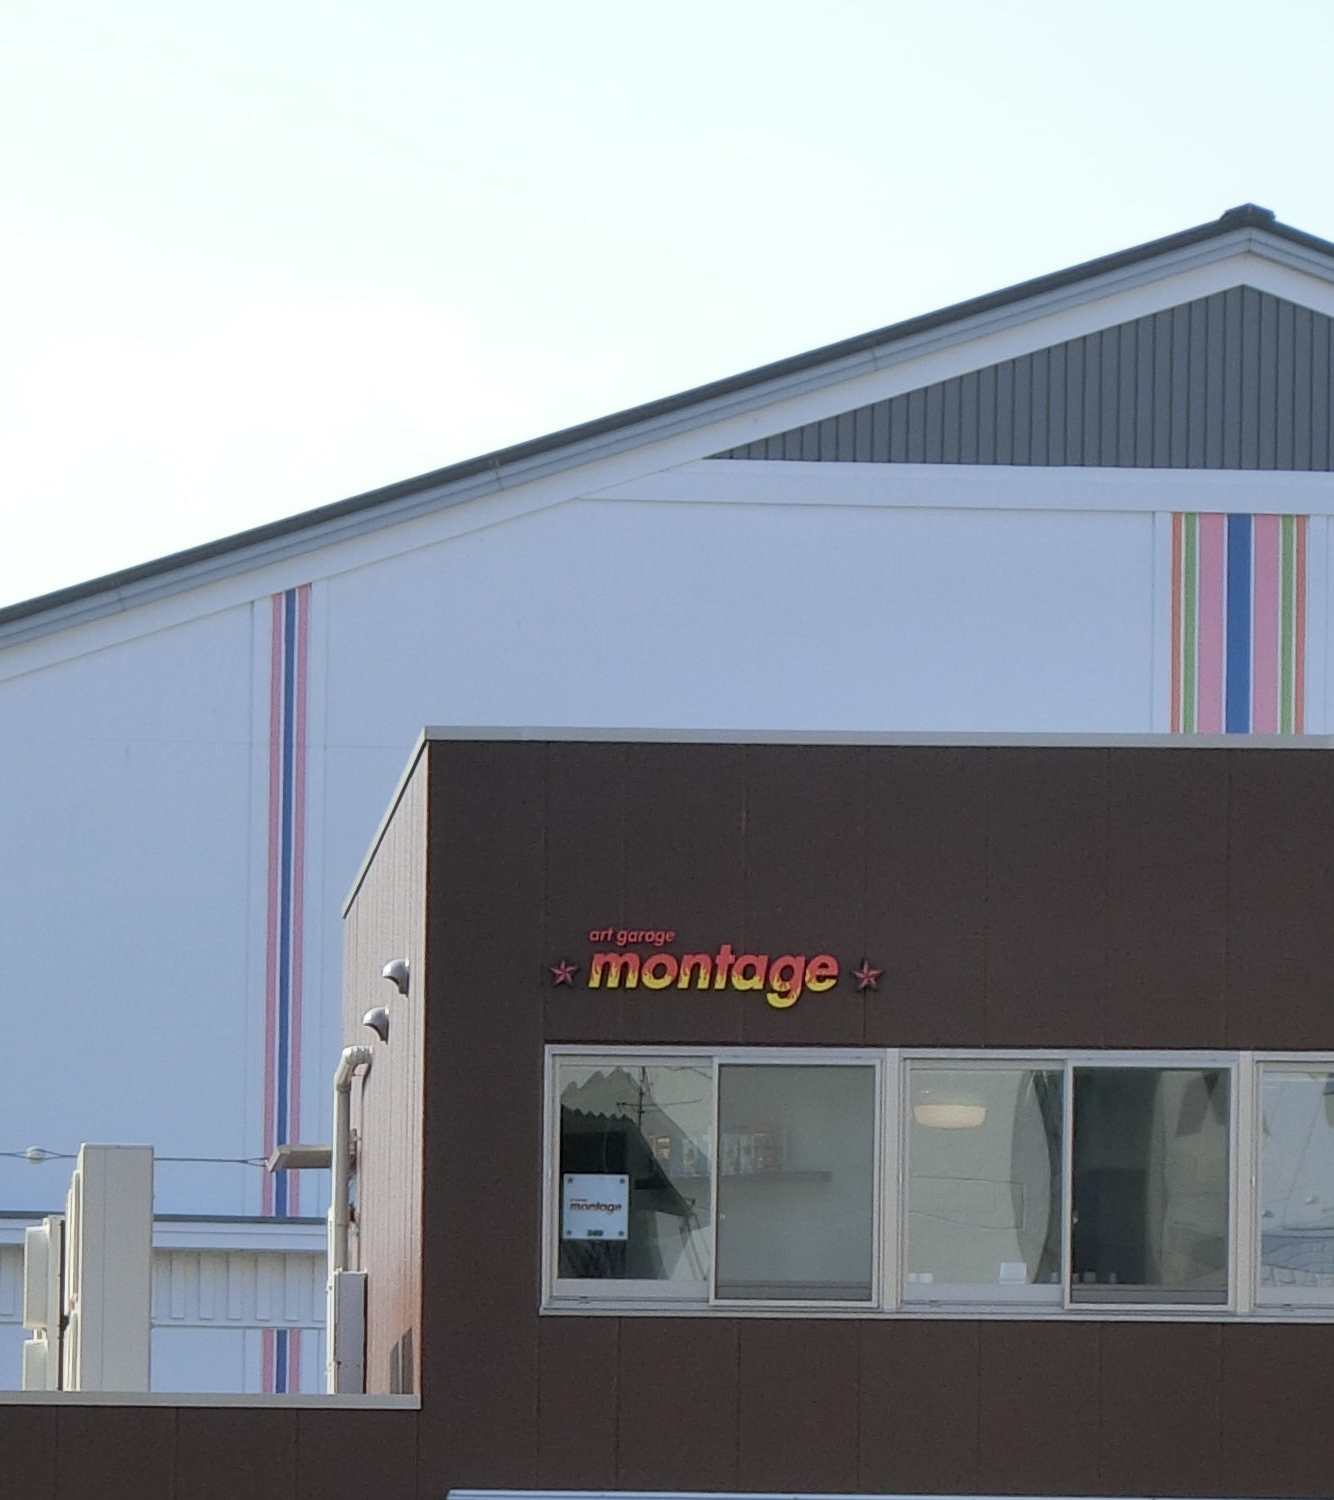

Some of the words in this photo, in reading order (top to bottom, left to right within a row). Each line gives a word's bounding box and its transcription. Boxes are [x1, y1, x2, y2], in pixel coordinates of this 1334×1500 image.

[589, 927, 614, 942] art
[617, 930, 676, 946] garage
[587, 943, 840, 1009] montage
